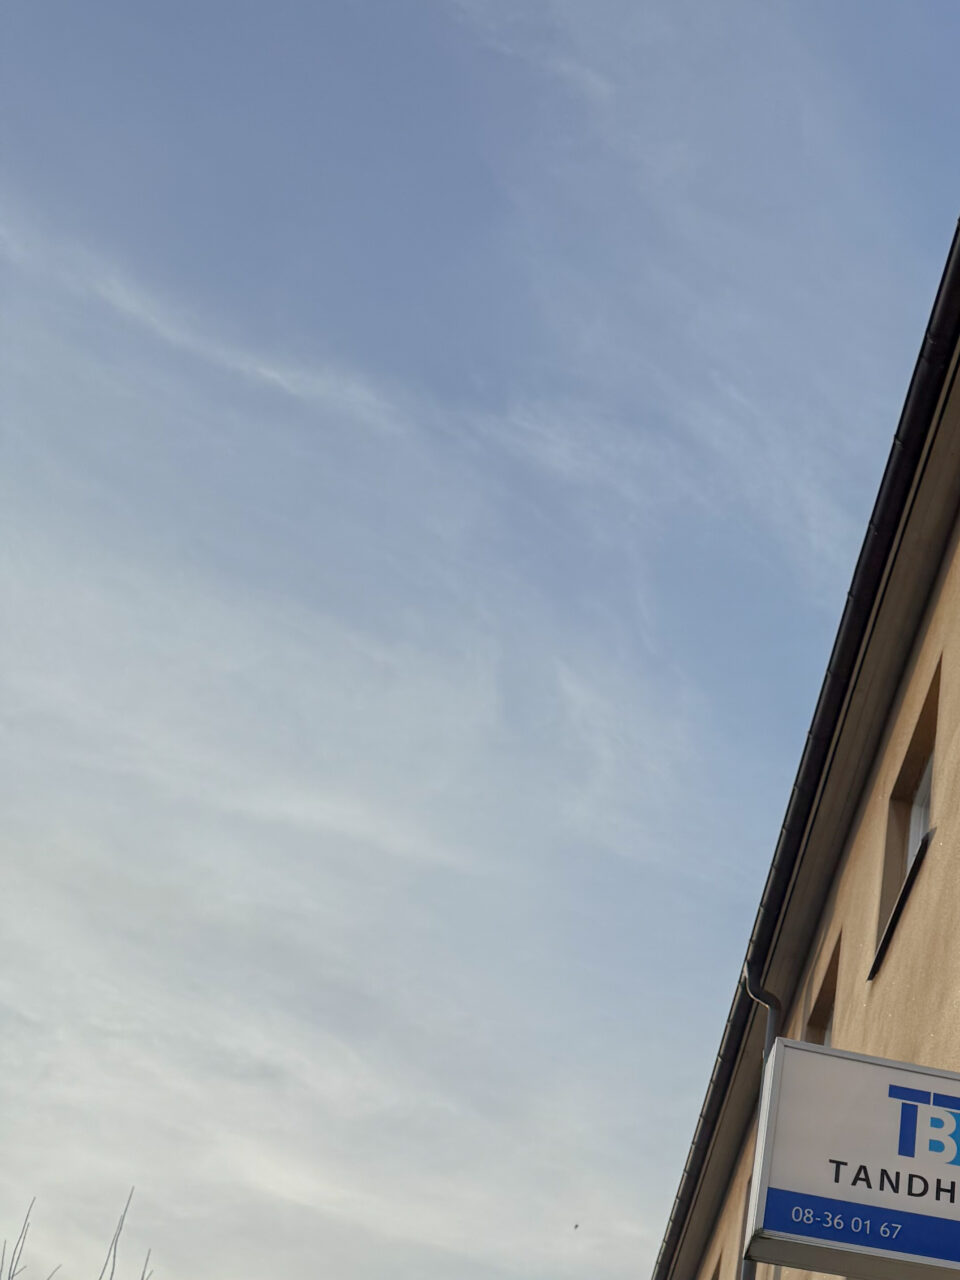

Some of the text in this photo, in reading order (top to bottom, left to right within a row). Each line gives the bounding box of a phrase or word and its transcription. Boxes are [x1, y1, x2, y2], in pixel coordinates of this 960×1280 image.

[791, 1206, 903, 1240] 08-36 01 67
